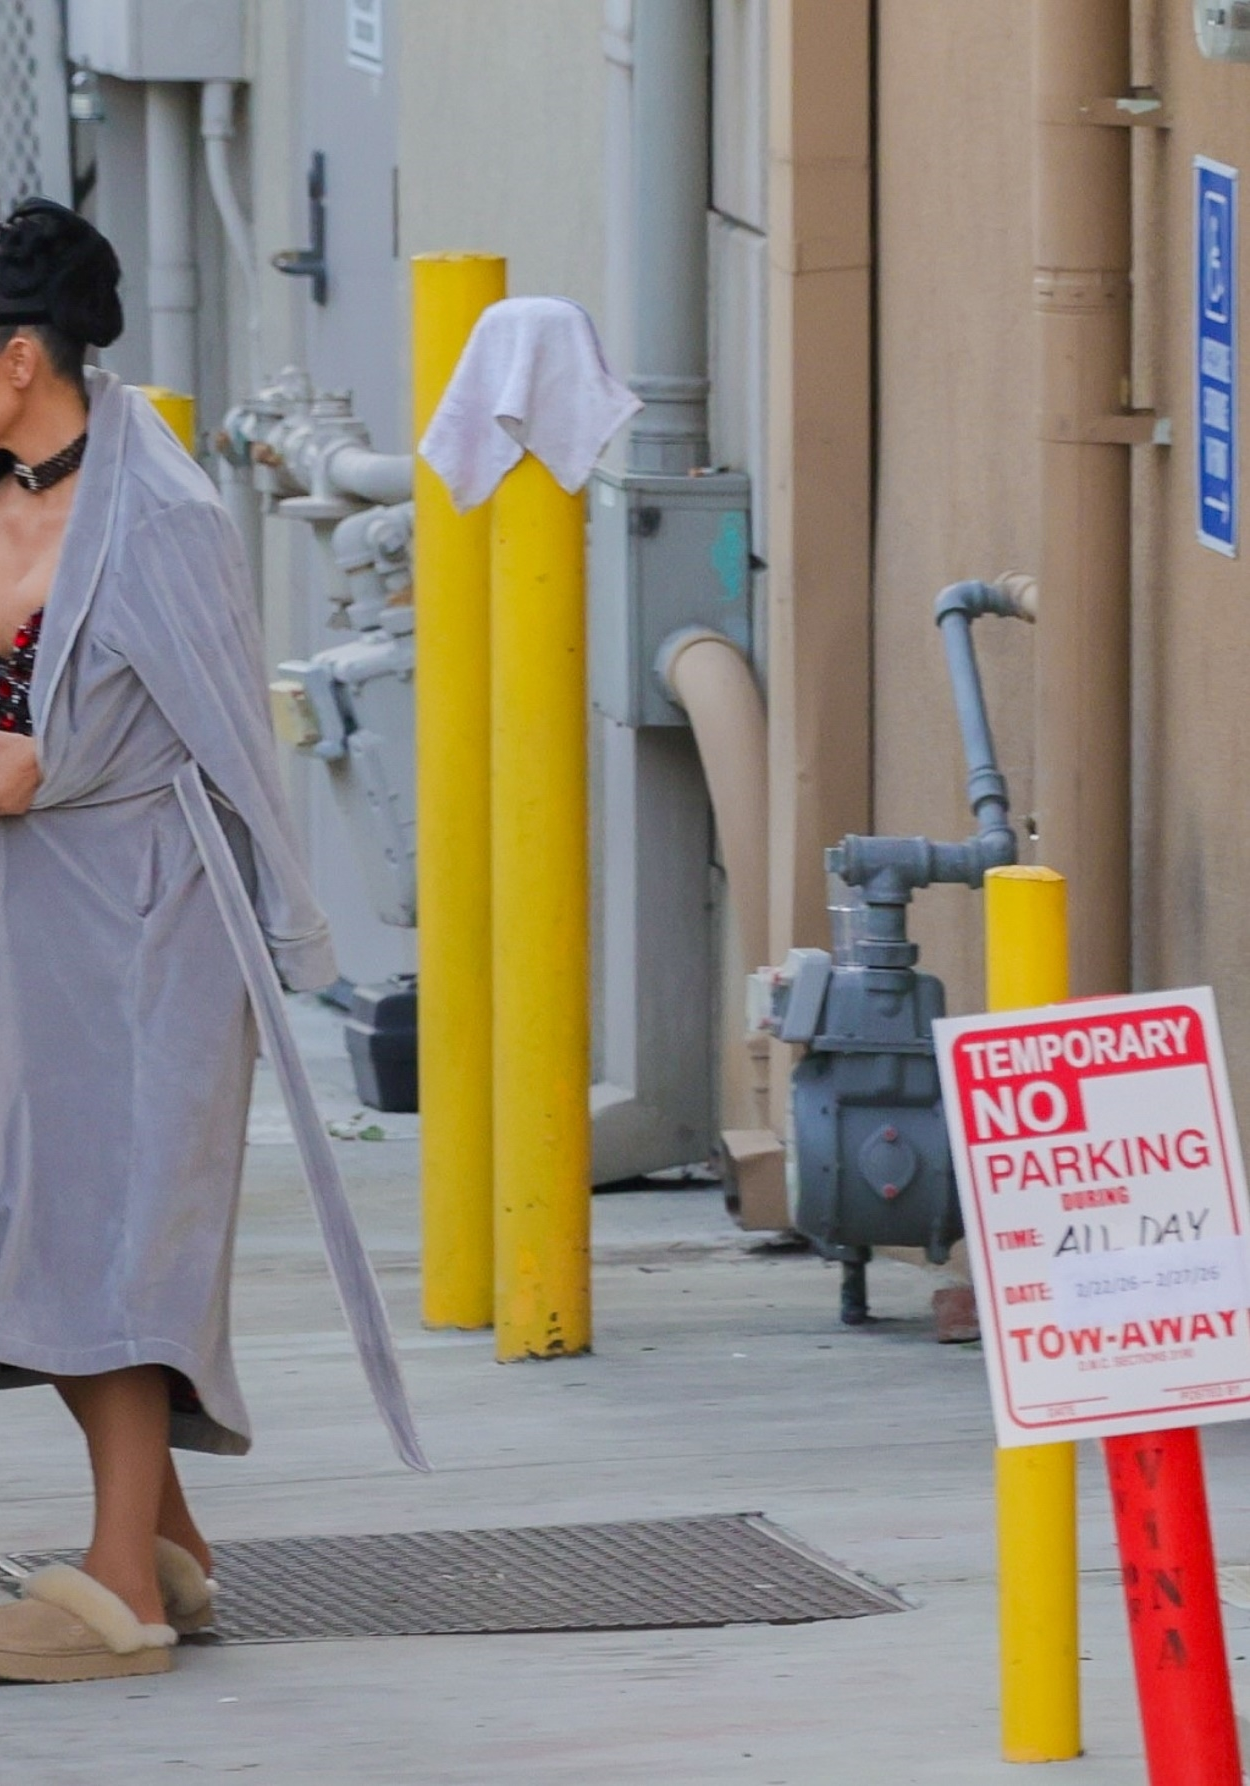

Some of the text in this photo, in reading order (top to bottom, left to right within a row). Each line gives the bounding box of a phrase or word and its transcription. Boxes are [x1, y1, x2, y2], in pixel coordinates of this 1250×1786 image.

[962, 1017, 1190, 1080] TEMPORARY
[971, 1080, 1069, 1140] NO
[986, 1128, 1211, 1194] PARKING
[1061, 1186, 1130, 1212] DURING
[1139, 1208, 1209, 1247] DAY
[1009, 1309, 1236, 1363] TOW-AWAY
